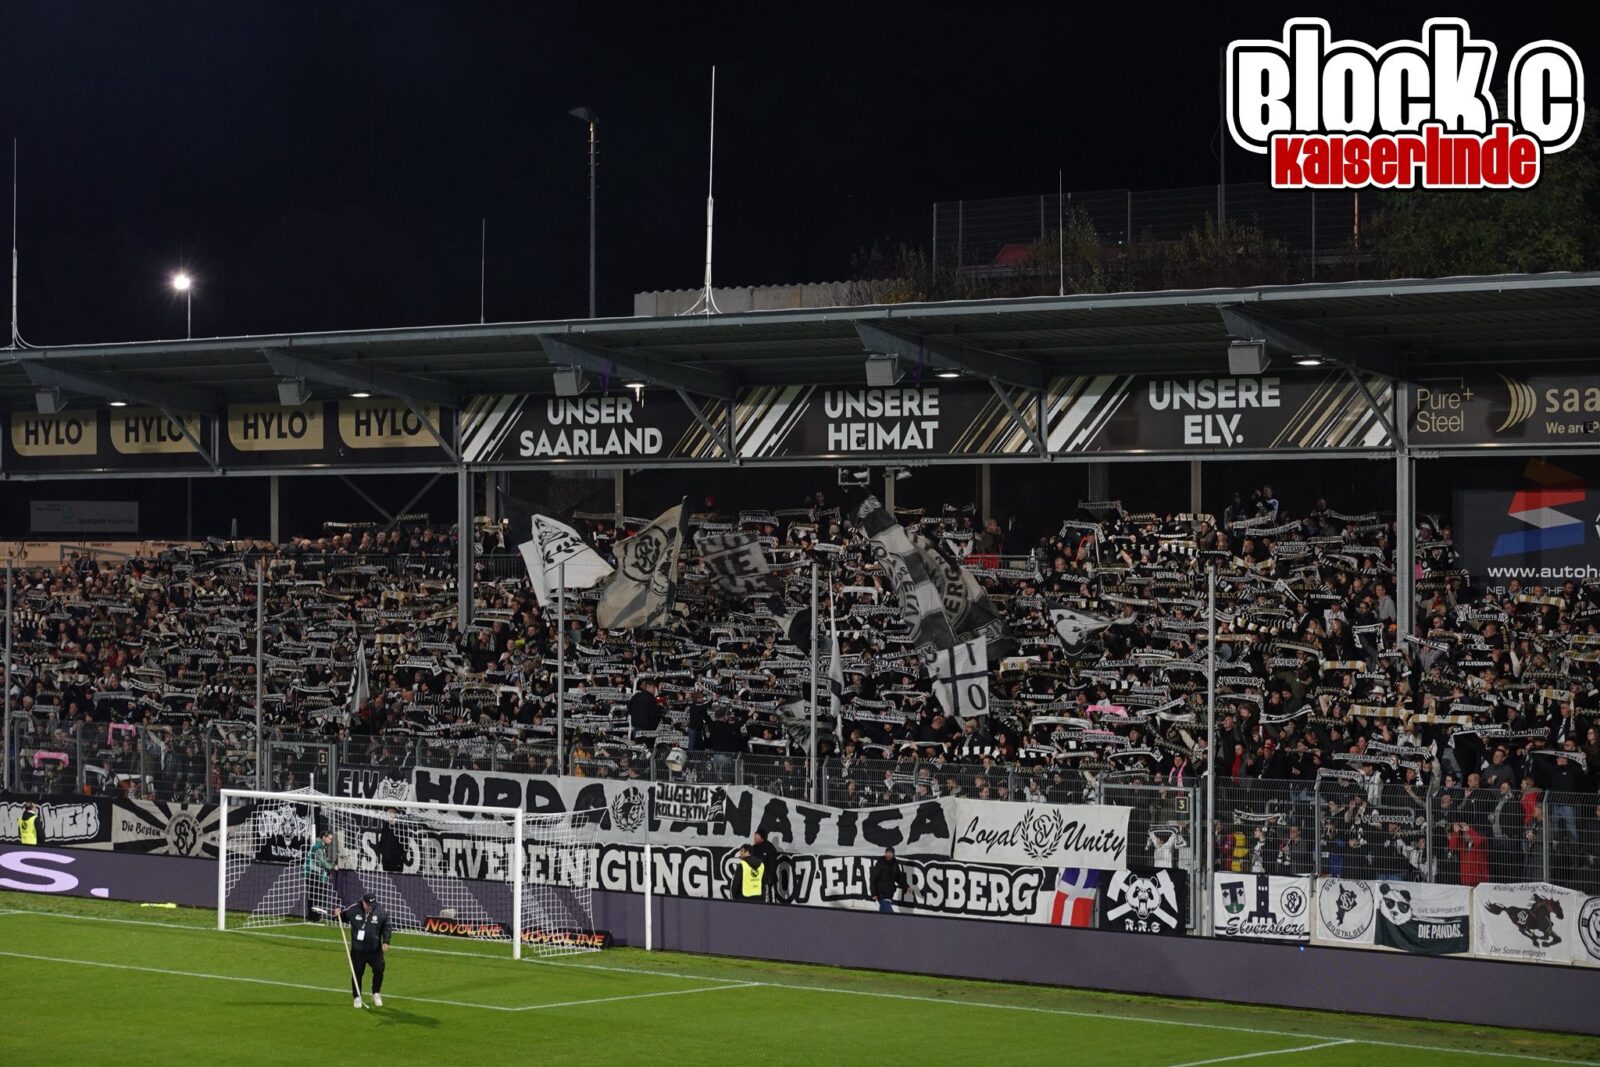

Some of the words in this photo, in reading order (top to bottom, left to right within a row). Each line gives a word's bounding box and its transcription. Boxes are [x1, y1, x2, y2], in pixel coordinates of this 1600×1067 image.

[824, 388, 939, 419] UNSERE
[1149, 377, 1280, 410] UNSERE
[547, 397, 634, 425] UNSER
[1416, 411, 1464, 432] Steel
[828, 420, 939, 452] HEIMAT
[1184, 413, 1244, 447] ELV.
[1545, 421, 1565, 434] We
[519, 427, 663, 457] SAARLAND
[1487, 564, 1600, 578] www.autoh
[657, 782, 709, 804] JUGEND
[1178, 799, 1185, 809] 3
[655, 802, 709, 820] KOLLEKTIV
[957, 816, 1022, 854] Loyal
[1062, 820, 1127, 861] Unity
[361, 830, 709, 898] SORTVEREINIGUNG
[823, 856, 1040, 913] ELVRSBERG
[1226, 917, 1305, 937] Elversberg
[1417, 924, 1431, 939] DIE
